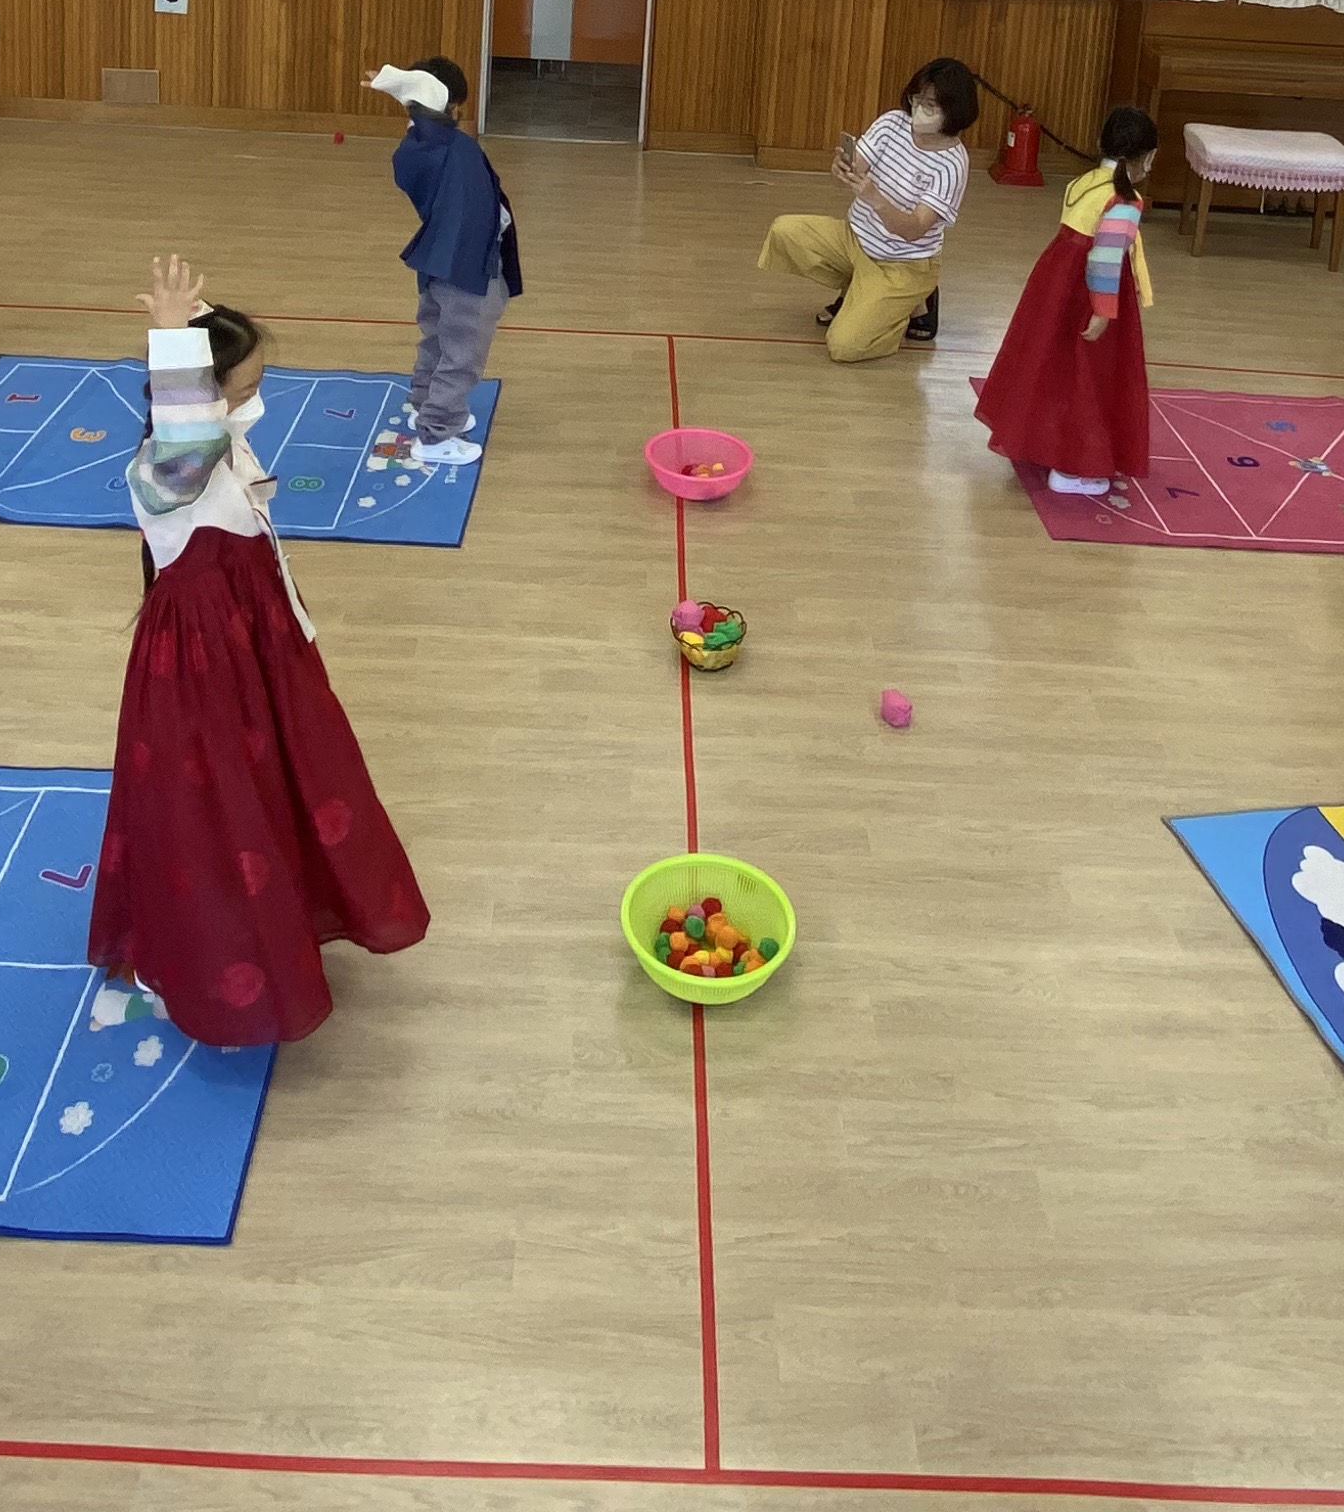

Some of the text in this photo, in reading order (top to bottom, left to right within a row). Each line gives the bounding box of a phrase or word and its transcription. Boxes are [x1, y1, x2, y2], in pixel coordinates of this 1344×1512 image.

[5, 393, 42, 403] 1
[324, 409, 356, 419] 7
[70, 428, 106, 442] 3
[1227, 456, 1260, 467] 6
[288, 476, 324, 491] 8
[1165, 487, 1200, 499] 7
[39, 864, 95, 891] 7
